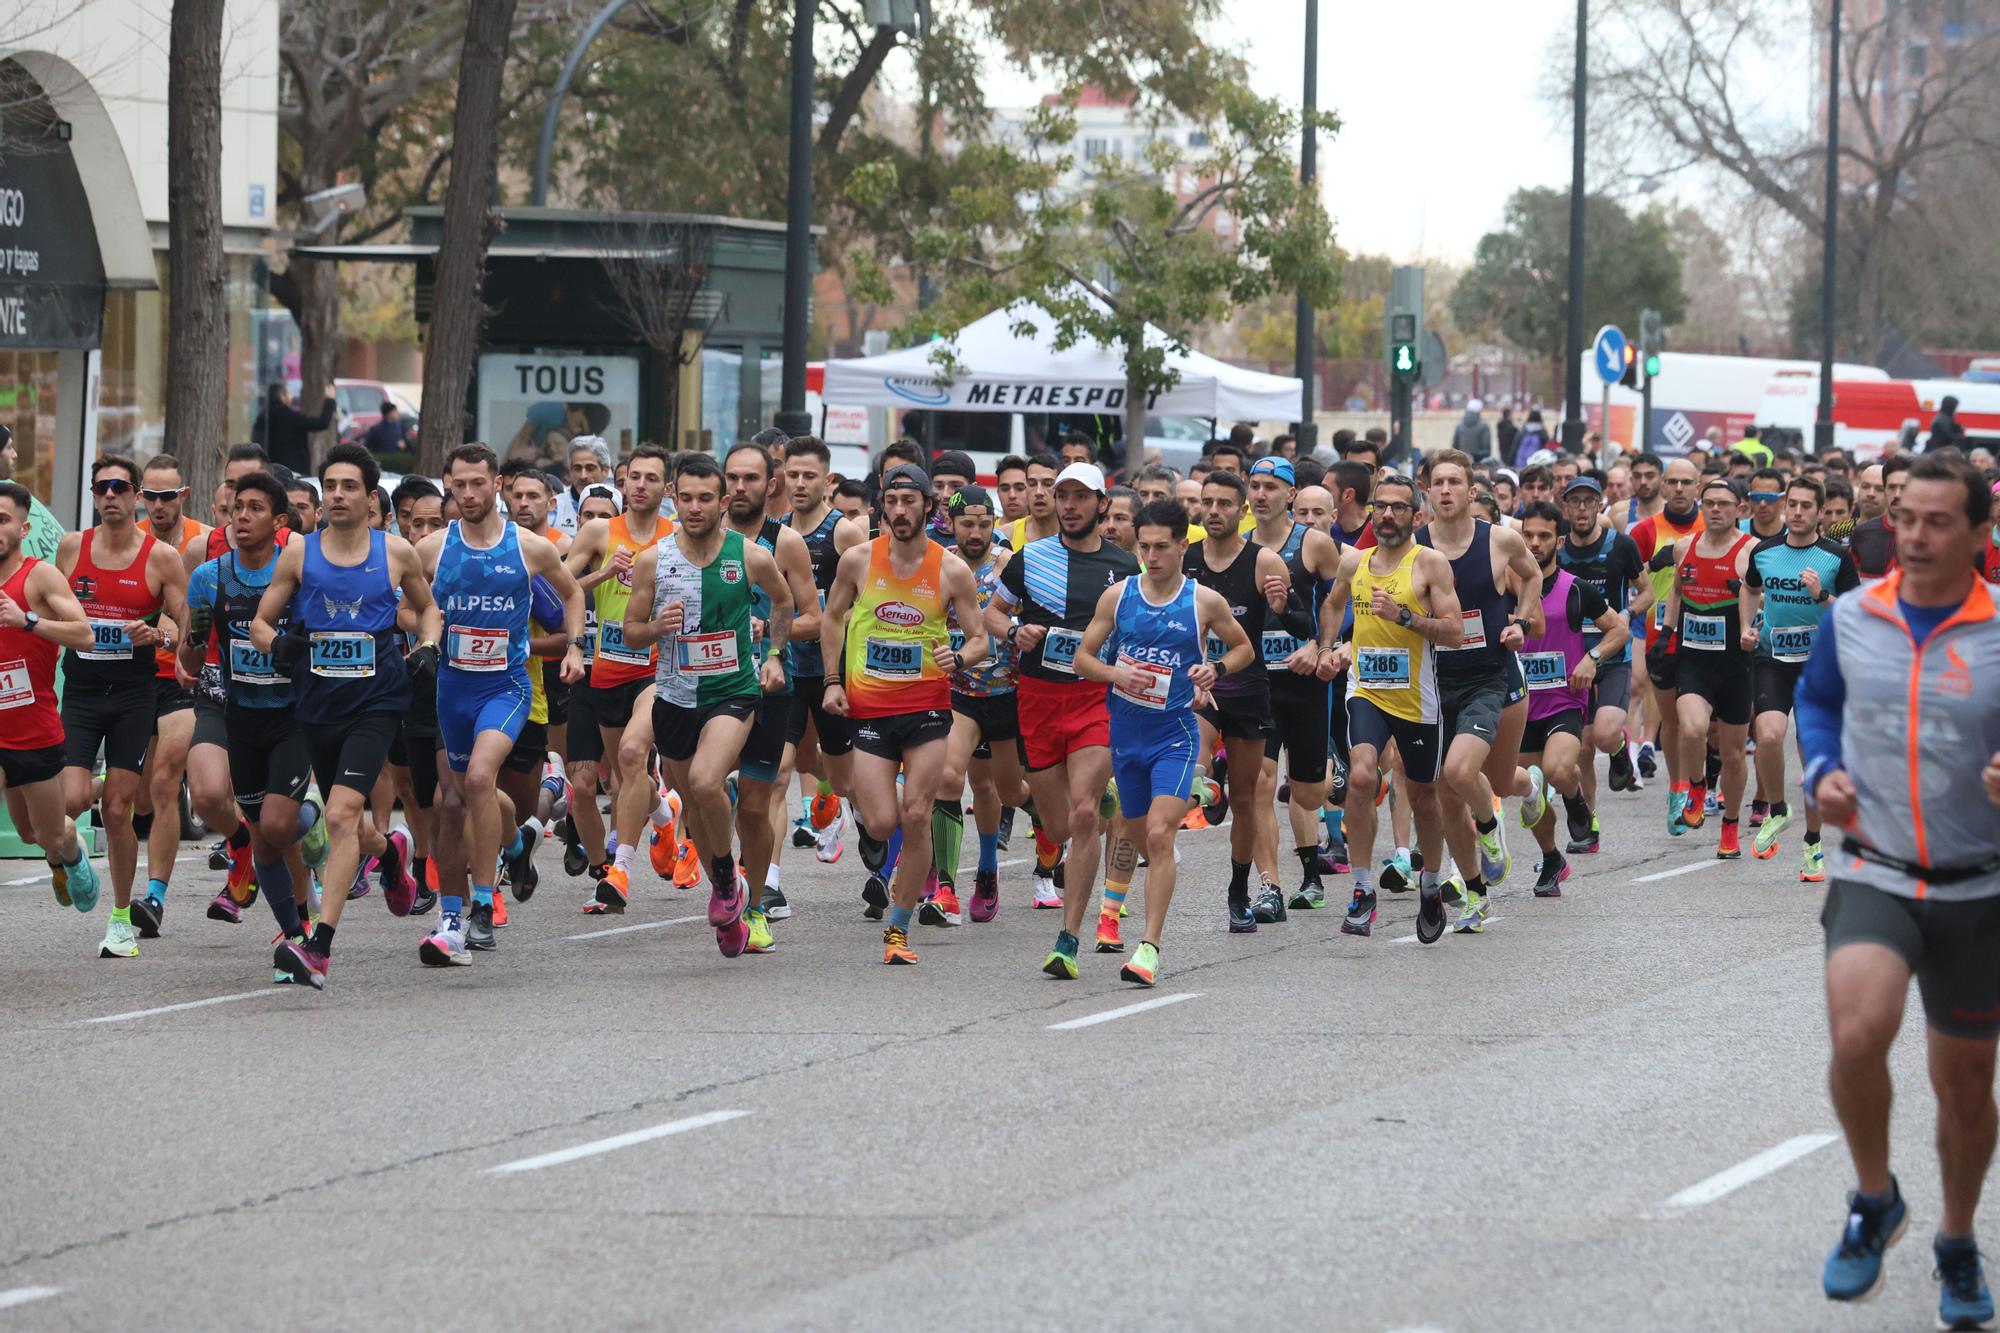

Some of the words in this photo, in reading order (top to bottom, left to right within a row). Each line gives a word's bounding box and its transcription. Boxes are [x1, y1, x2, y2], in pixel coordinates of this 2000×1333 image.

[14, 244, 39, 276] tapas
[514, 365, 605, 395] TOUS
[965, 383, 1160, 411] METAESPOT
[446, 595, 515, 611] ALPESA
[1771, 593, 1811, 605] RUNNERS
[880, 607, 921, 623] Serrano
[93, 626, 122, 645] 189
[605, 627, 624, 645] 23
[1688, 620, 1716, 637] 2448
[471, 639, 495, 654] 27
[951, 635, 966, 651] 22
[1054, 636, 1079, 655] 25
[1777, 632, 1811, 648] 2426
[241, 649, 273, 668] 221
[321, 640, 362, 659] 2251
[701, 643, 723, 658] 15
[872, 645, 912, 664] 2298
[1364, 655, 1399, 673] 2186
[1523, 658, 1556, 675] 2361
